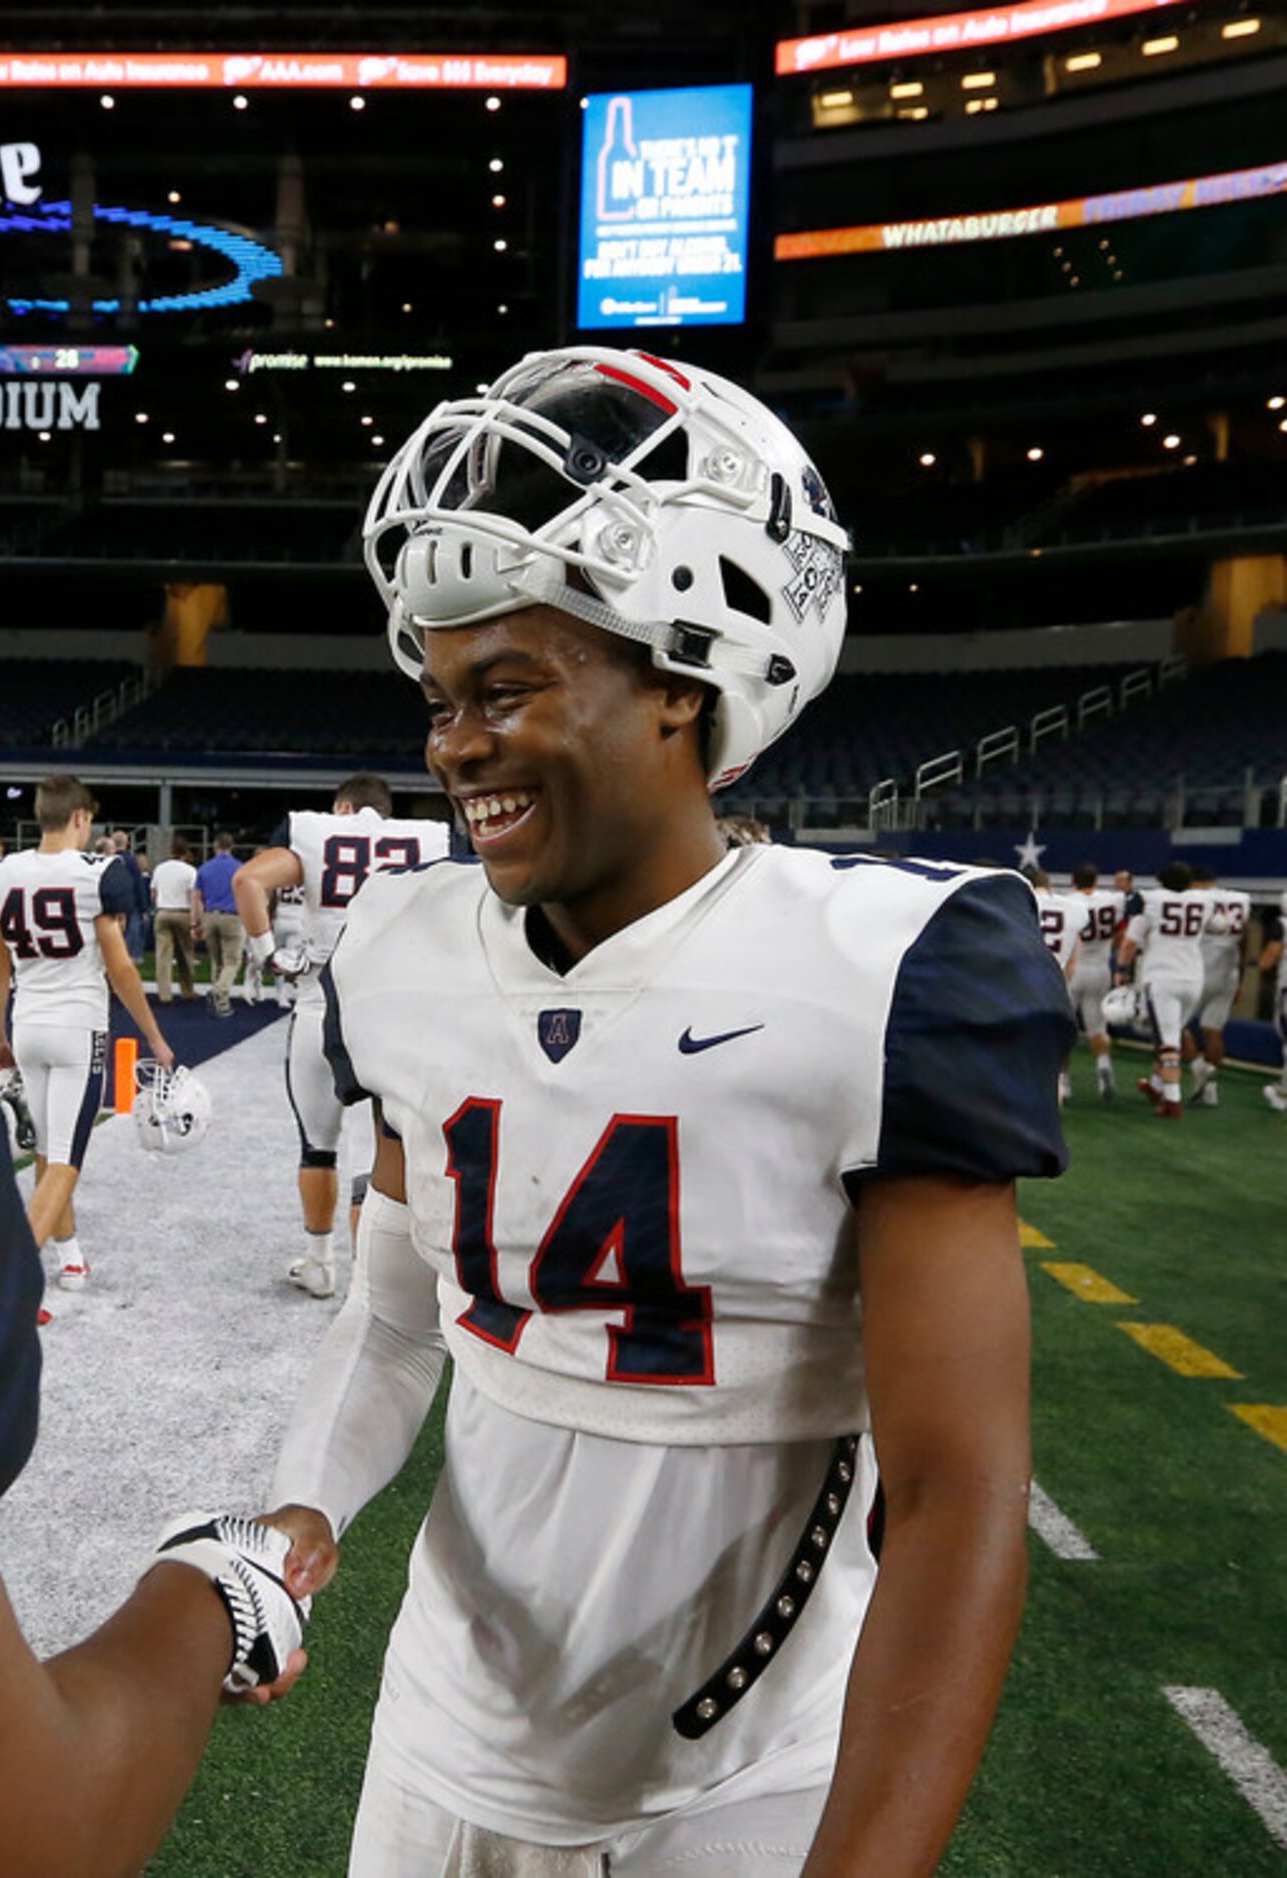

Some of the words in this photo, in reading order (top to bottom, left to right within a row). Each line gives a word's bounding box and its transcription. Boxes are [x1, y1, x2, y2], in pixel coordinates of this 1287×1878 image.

[612, 158, 644, 200] IN
[647, 155, 736, 197] TEAM
[882, 204, 1058, 250] WHATABURGER
[0, 886, 86, 961] 49
[1159, 900, 1204, 938] 56
[546, 1013, 571, 1045] A
[442, 1095, 716, 1383] 14
